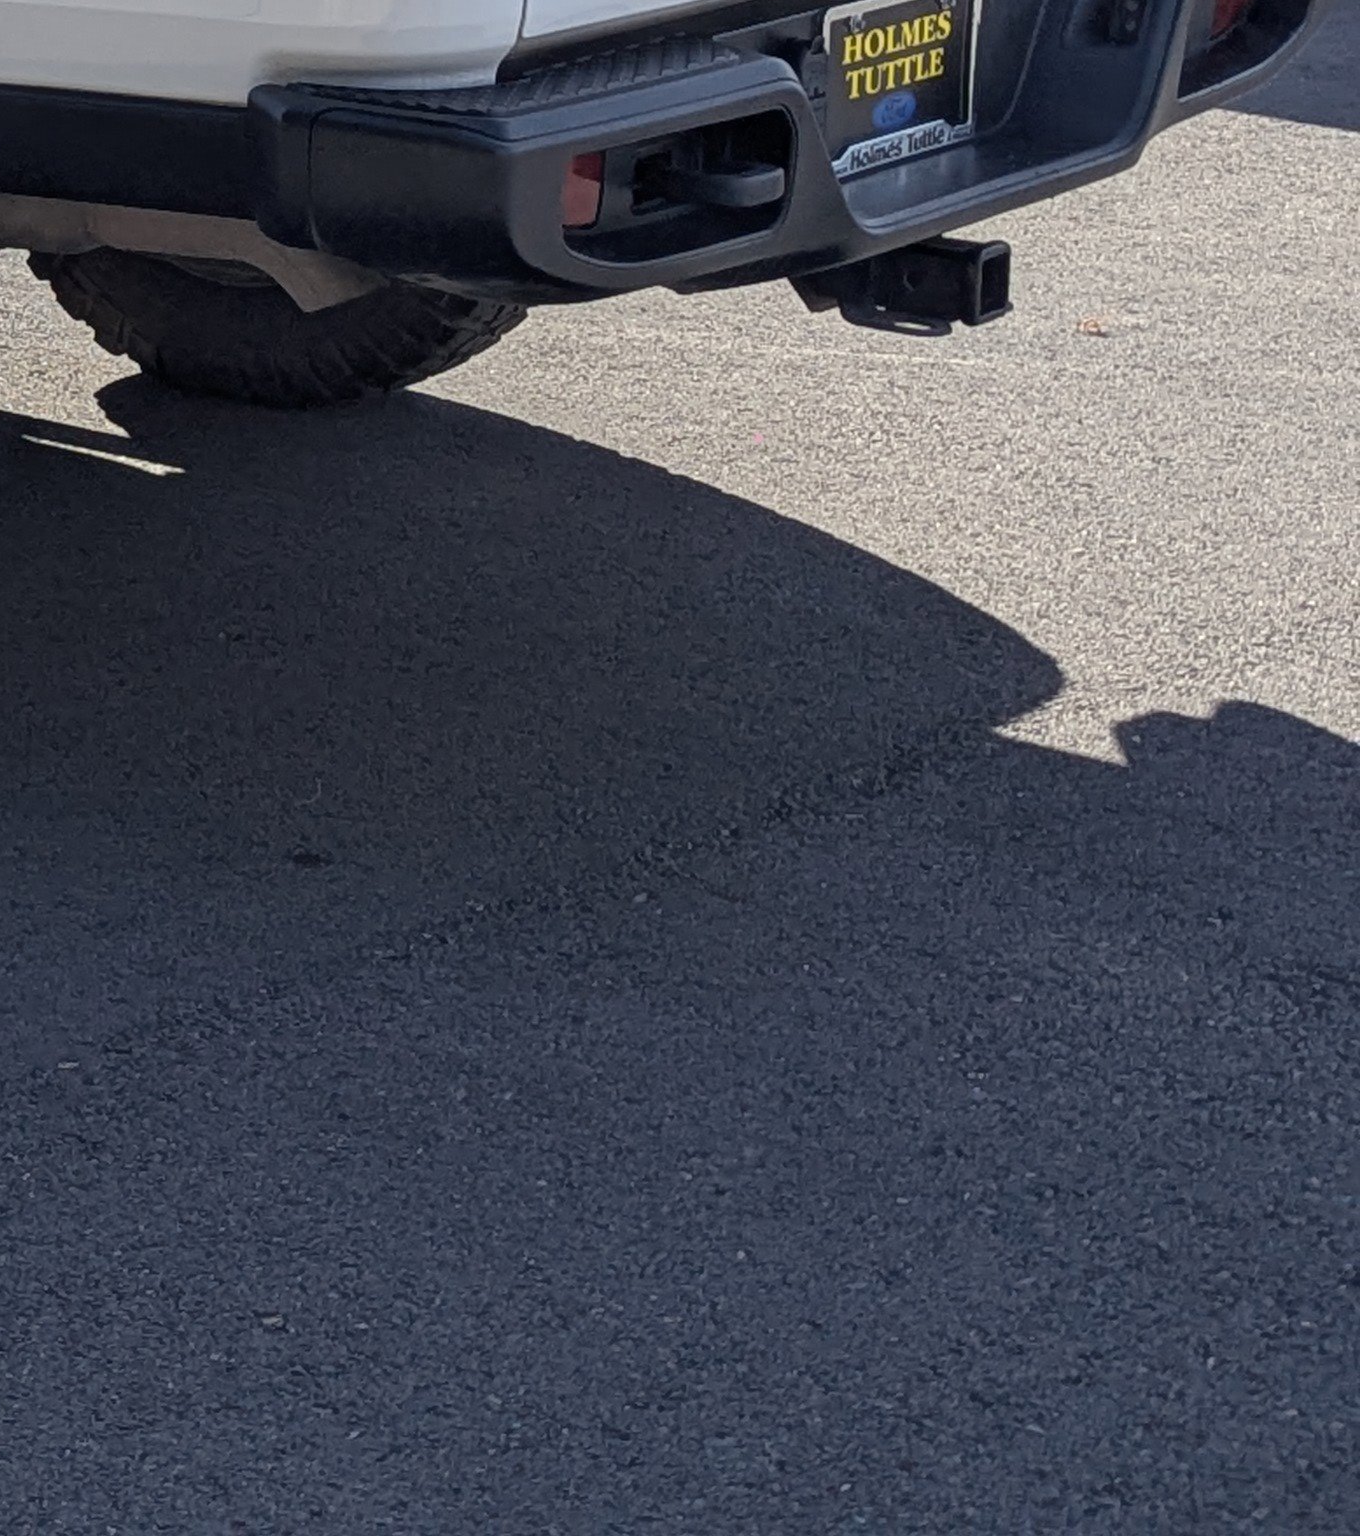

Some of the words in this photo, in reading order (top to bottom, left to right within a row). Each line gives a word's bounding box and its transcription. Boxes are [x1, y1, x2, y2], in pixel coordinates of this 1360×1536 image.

[841, 10, 953, 66] HOLMES
[845, 48, 945, 100] TUTTLE
[849, 138, 903, 171] Holmes
[907, 125, 946, 154] Tuttle
